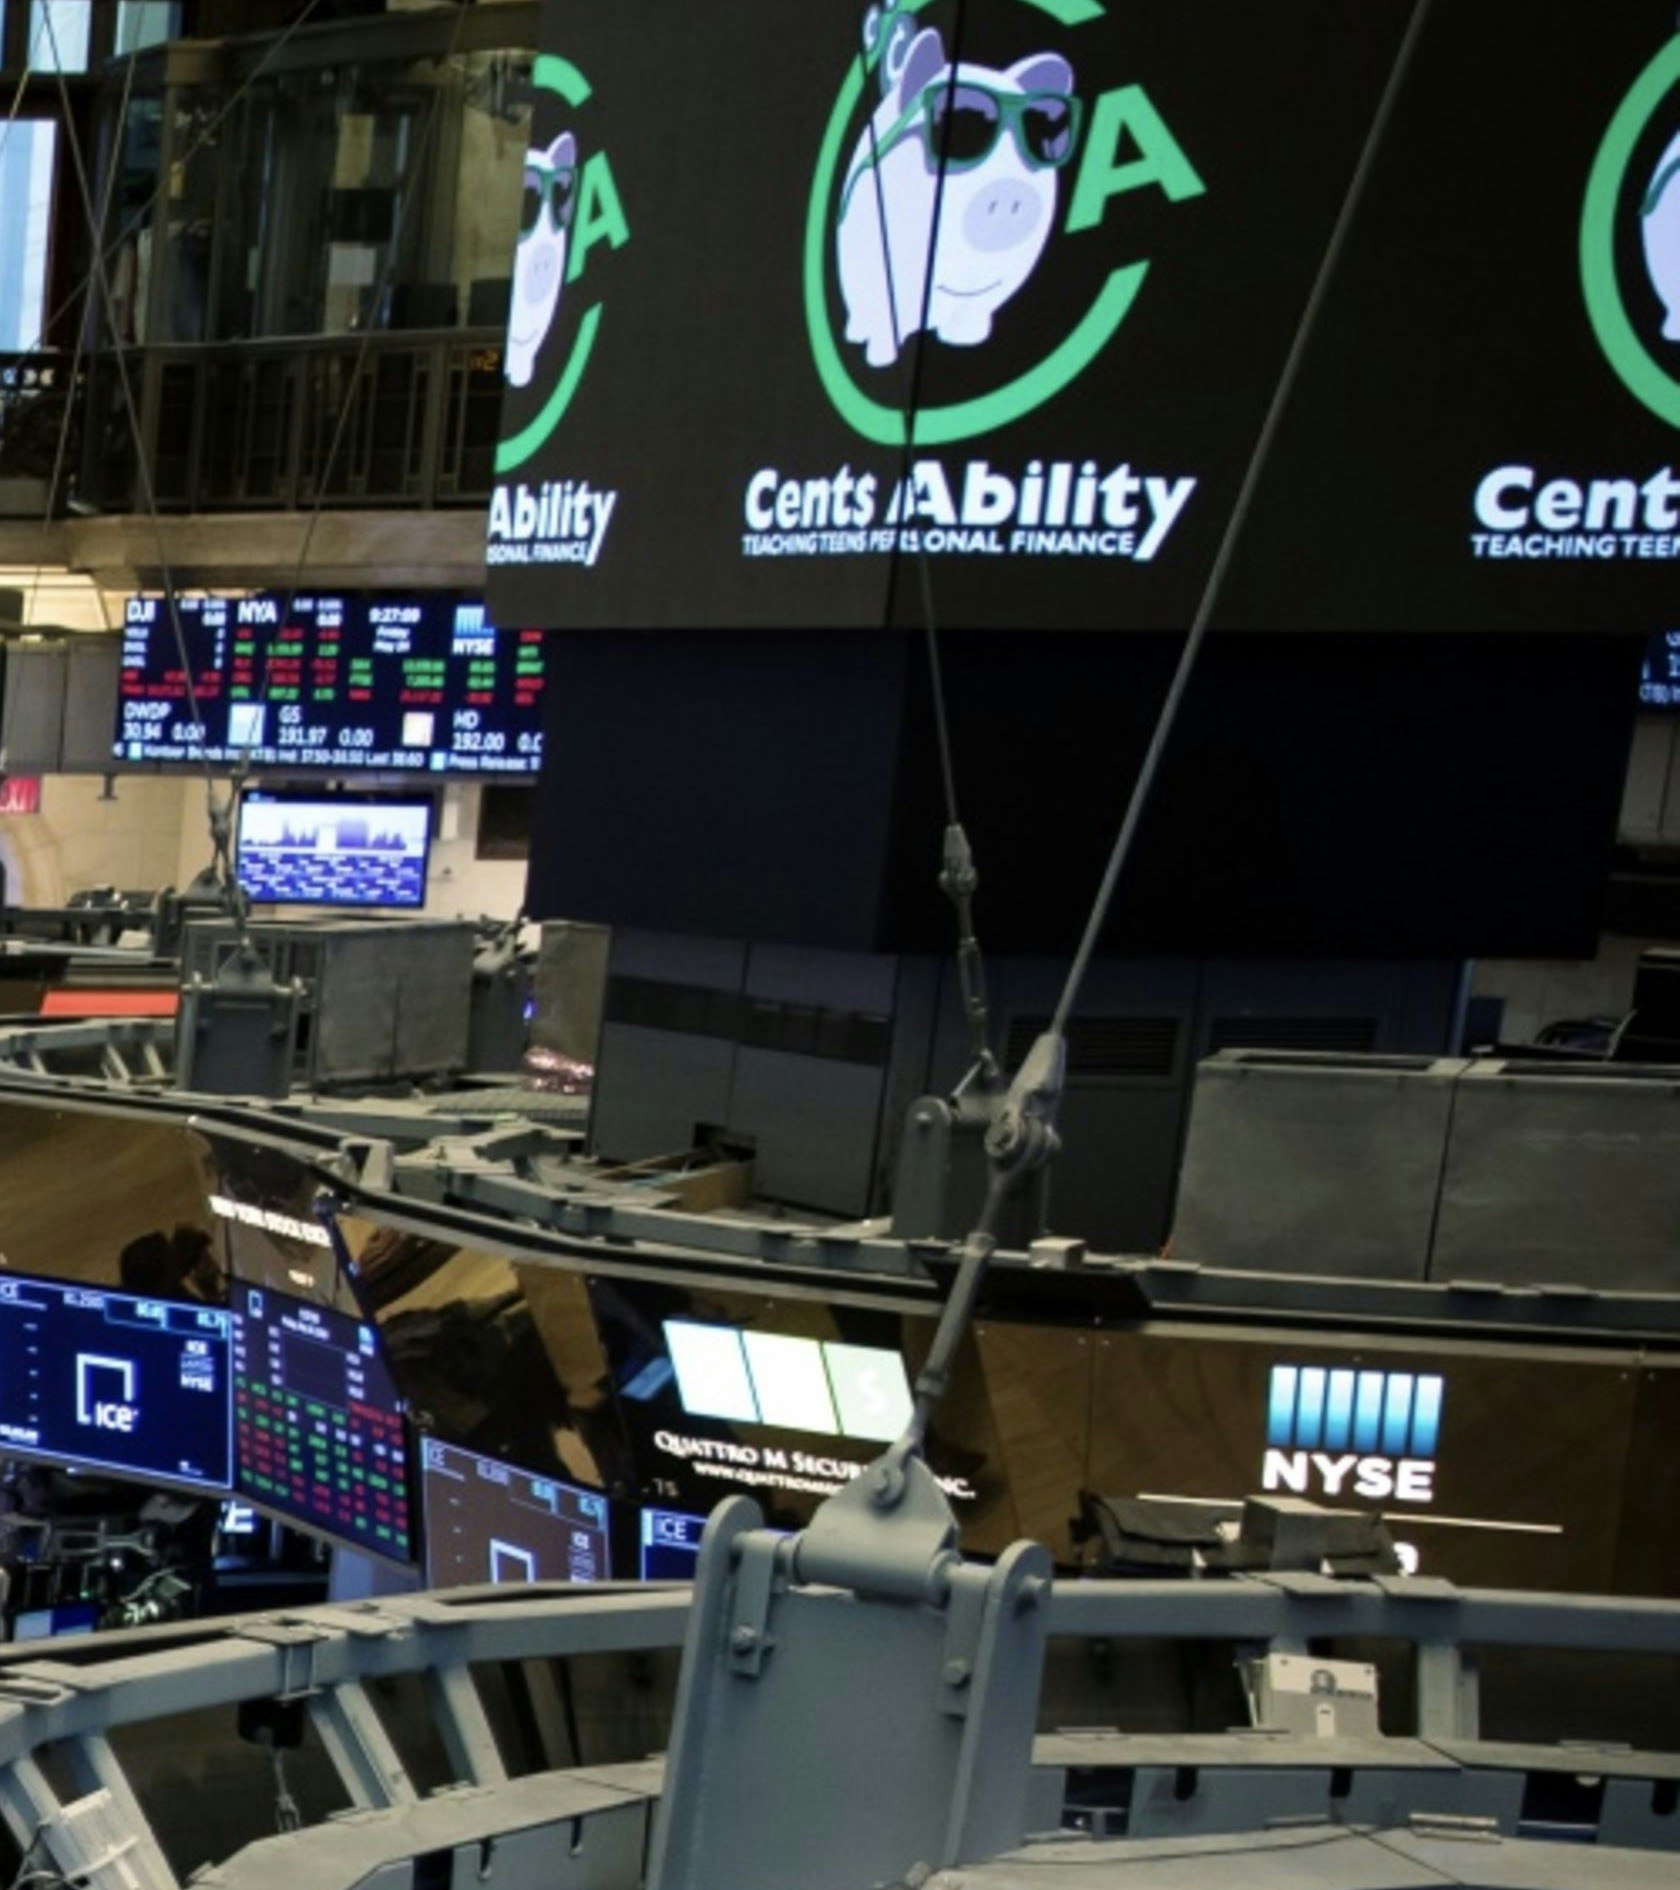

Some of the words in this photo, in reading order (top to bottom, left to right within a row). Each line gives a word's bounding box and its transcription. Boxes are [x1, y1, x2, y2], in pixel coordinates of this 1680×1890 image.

[745, 464, 874, 531] Cents
[1474, 465, 1680, 532] Cent
[912, 460, 1197, 561] Ability
[488, 480, 617, 567] Ability
[1012, 533, 1133, 556] FINANCE
[1471, 534, 1617, 558] TEACHING
[127, 602, 156, 621] DJI
[238, 602, 277, 622] NYA
[452, 638, 494, 655] NYSE
[279, 705, 300, 724] GS
[454, 712, 479, 729] HD
[339, 729, 373, 746] 0.00
[453, 733, 505, 751] 192.00
[94, 1401, 141, 1433] ICE
[654, 1430, 759, 1466] QUATTRO
[763, 1448, 787, 1469] M
[1263, 1447, 1434, 1502] NYSE
